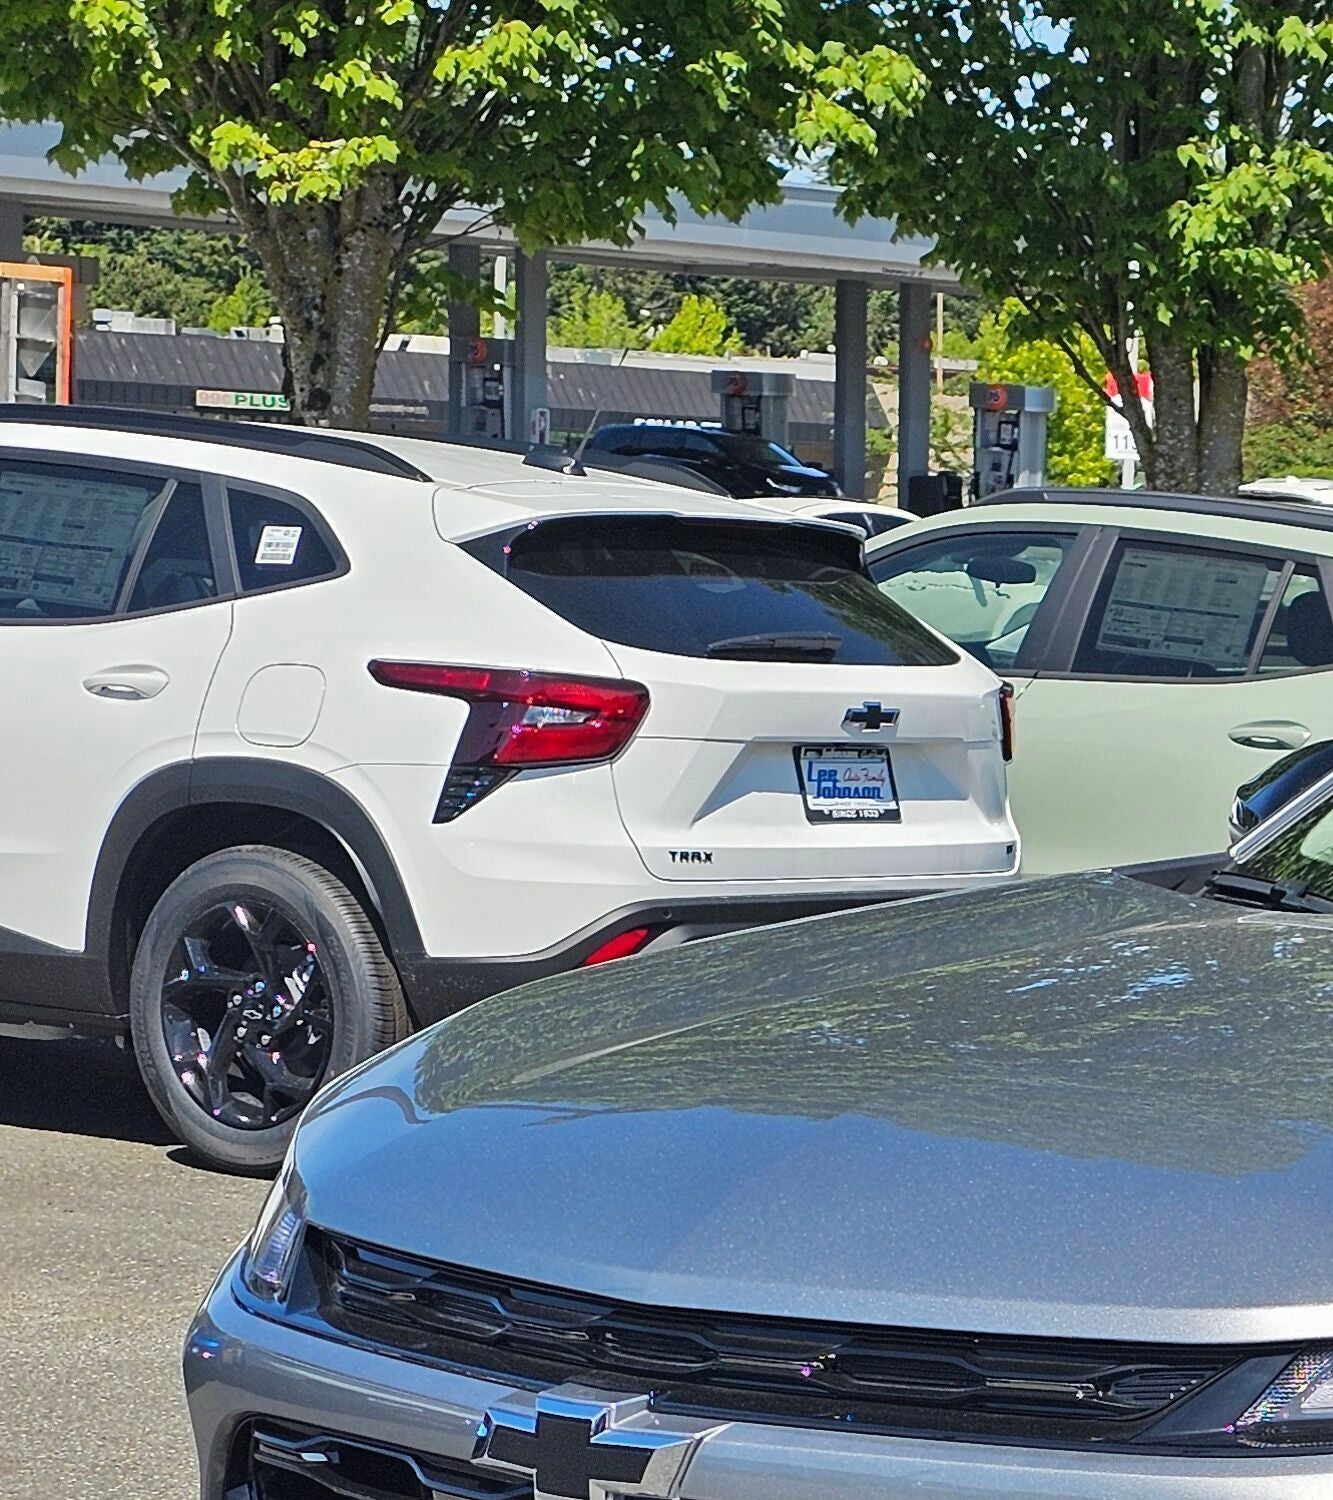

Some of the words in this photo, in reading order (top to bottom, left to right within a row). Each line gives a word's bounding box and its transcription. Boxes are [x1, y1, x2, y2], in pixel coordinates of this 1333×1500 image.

[234, 393, 289, 409] PLUS
[807, 760, 840, 782] Lee
[812, 779, 885, 799] Johnson
[668, 850, 713, 864] TRAX
